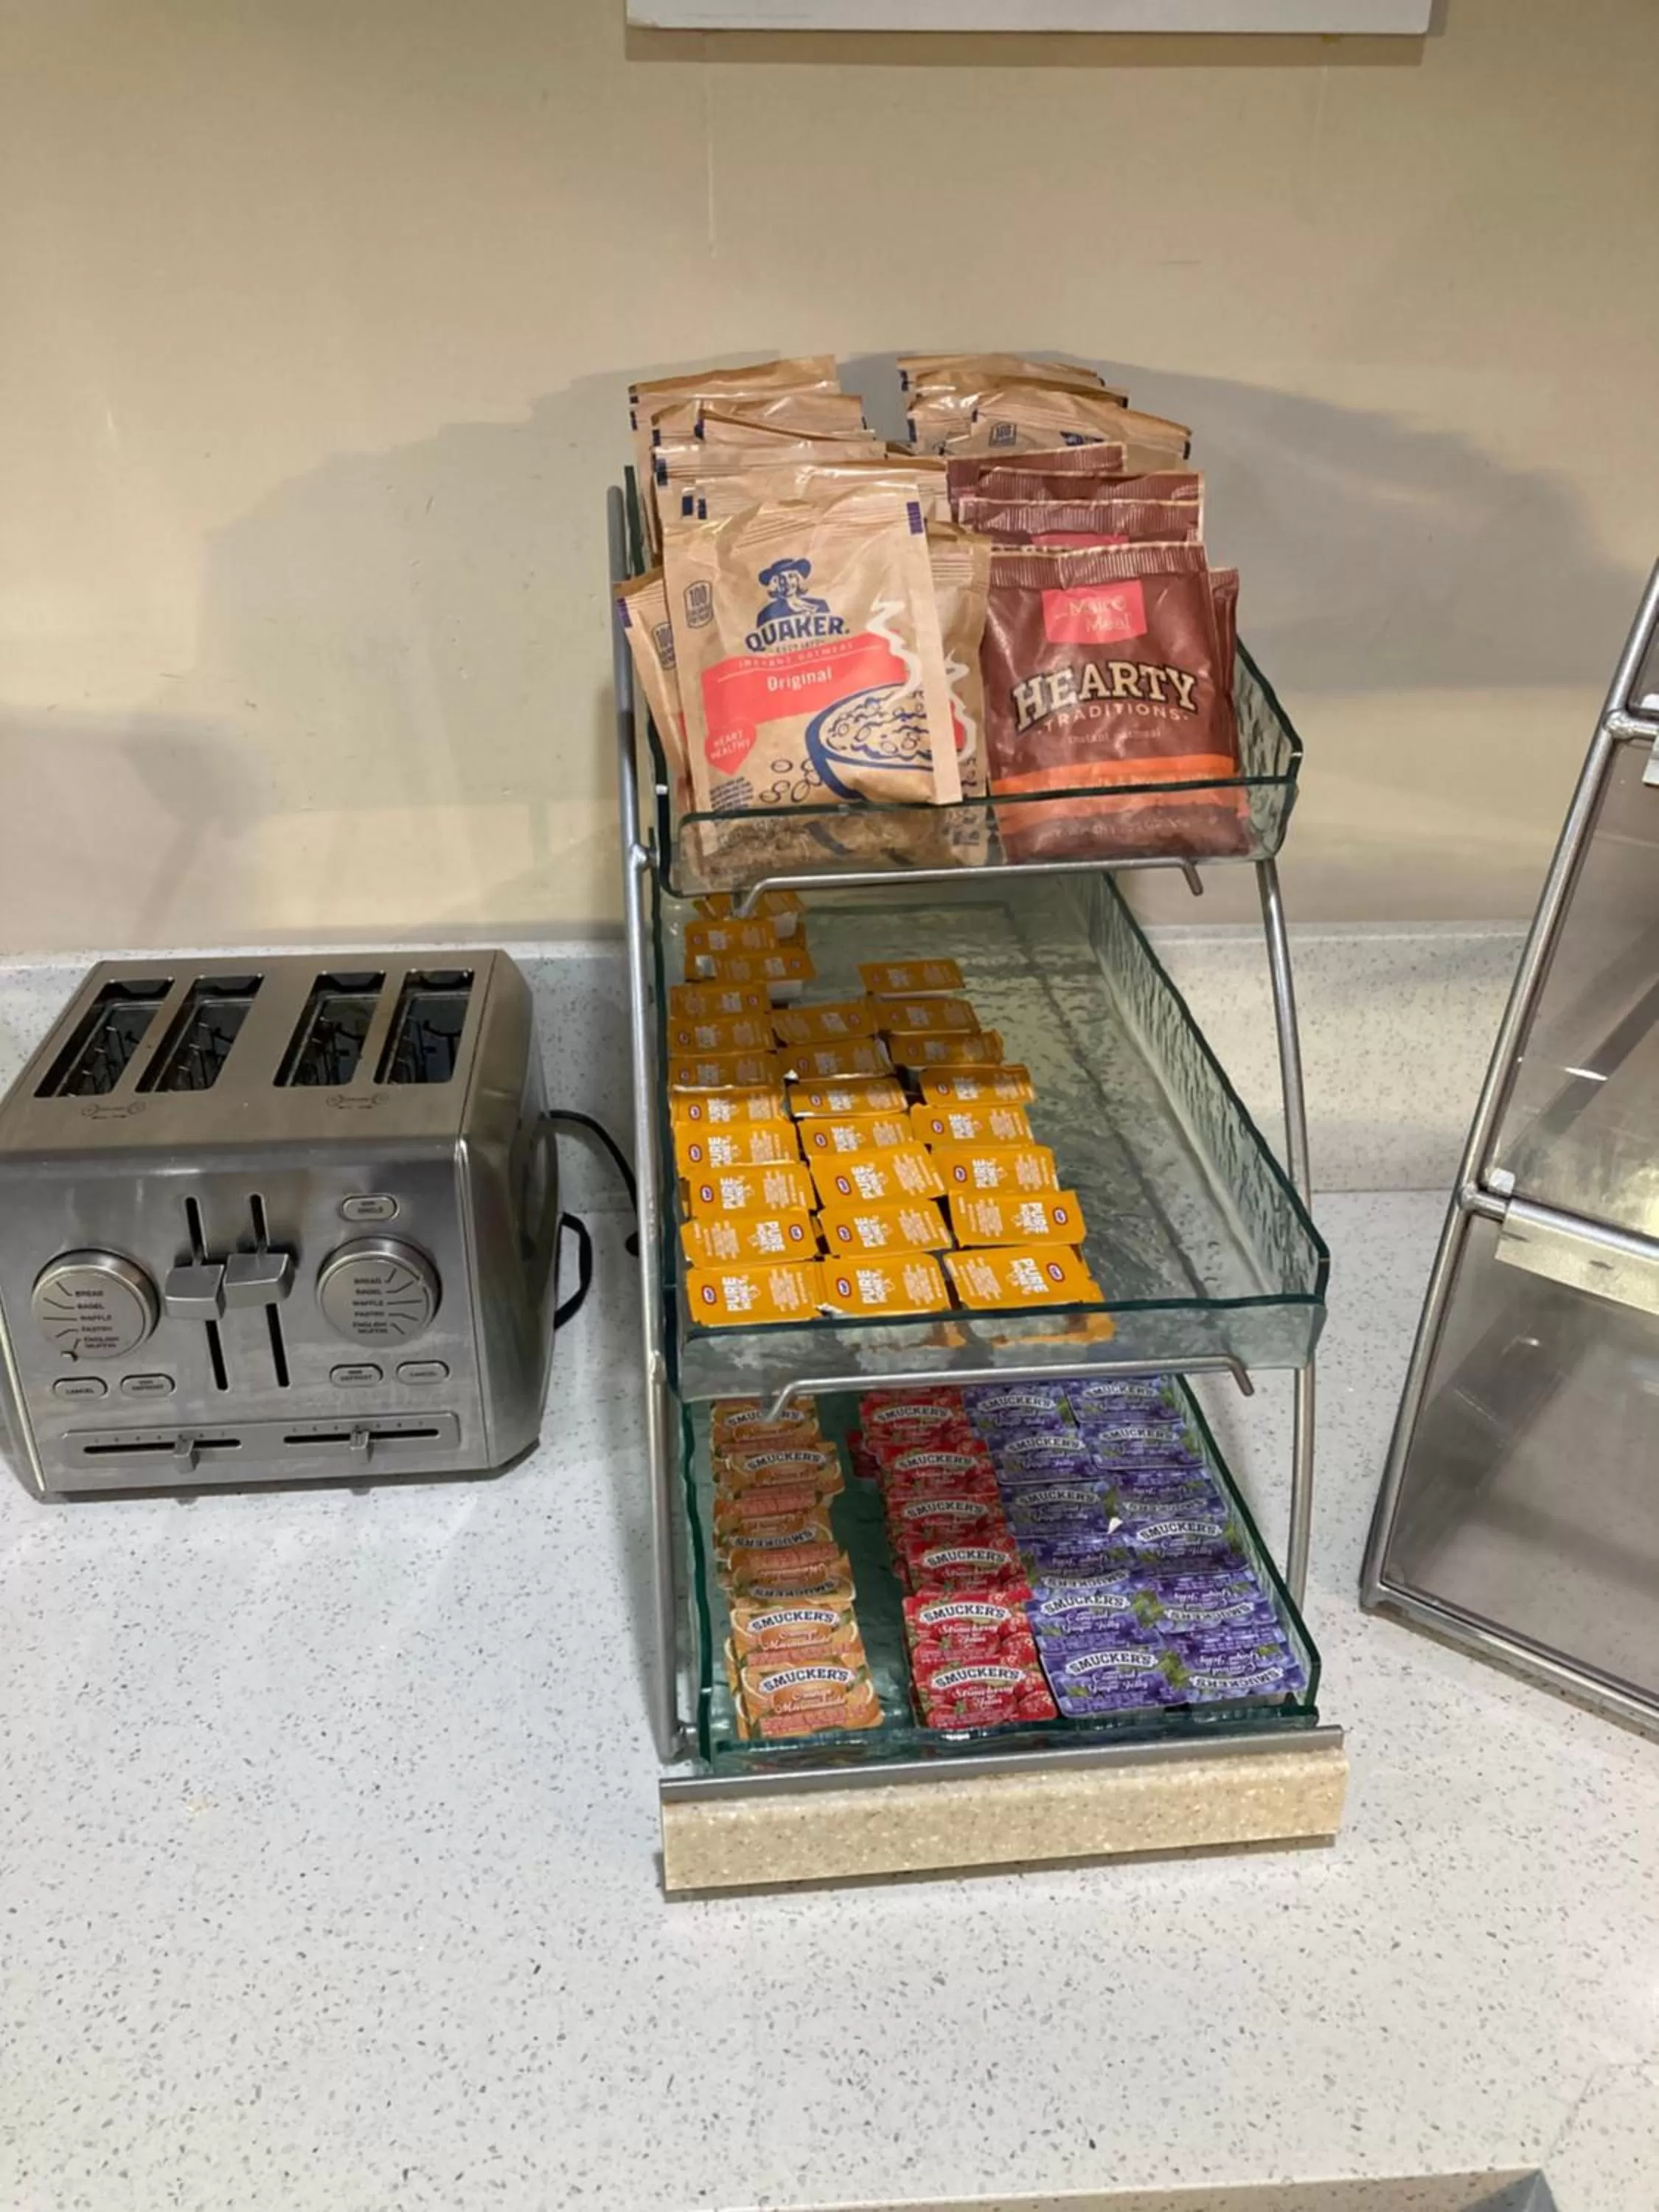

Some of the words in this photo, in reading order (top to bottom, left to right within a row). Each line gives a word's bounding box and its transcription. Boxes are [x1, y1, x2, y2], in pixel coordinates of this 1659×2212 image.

[745, 615, 844, 652] QUAKER
[767, 666, 832, 692] Original
[1011, 661, 1198, 734] HEARTY
[1044, 703, 1181, 732] TRADITIONS
